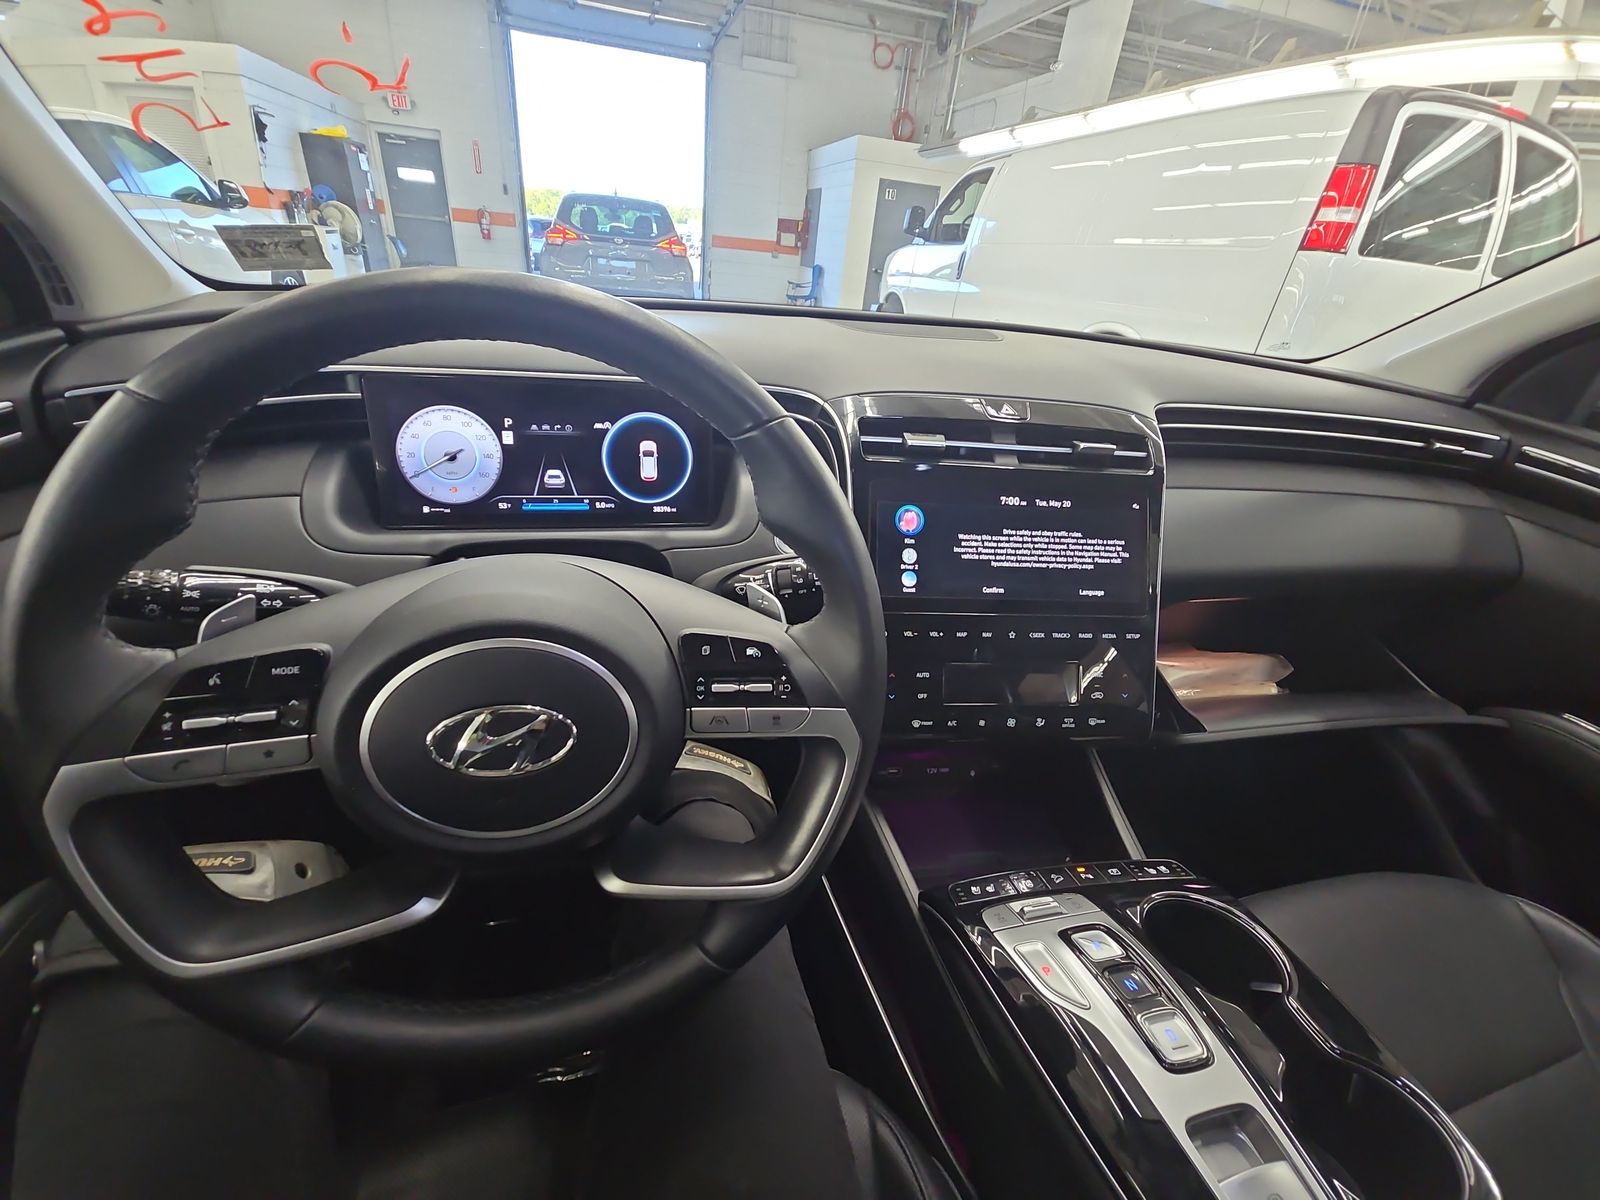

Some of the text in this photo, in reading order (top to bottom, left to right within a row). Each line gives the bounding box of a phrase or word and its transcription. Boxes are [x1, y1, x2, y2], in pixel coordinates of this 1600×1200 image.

[392, 93, 408, 109] EXIT
[886, 189, 896, 200] 10
[442, 414, 452, 422] 80
[504, 418, 512, 428] P
[1000, 496, 1020, 506] 7:00
[1049, 500, 1061, 509] May
[983, 586, 1004, 594] Confirm
[1079, 589, 1105, 597] Language
[272, 666, 300, 676] MODE
[1042, 966, 1051, 976] P
[1124, 979, 1138, 991] N
[1164, 1028, 1178, 1041] D
